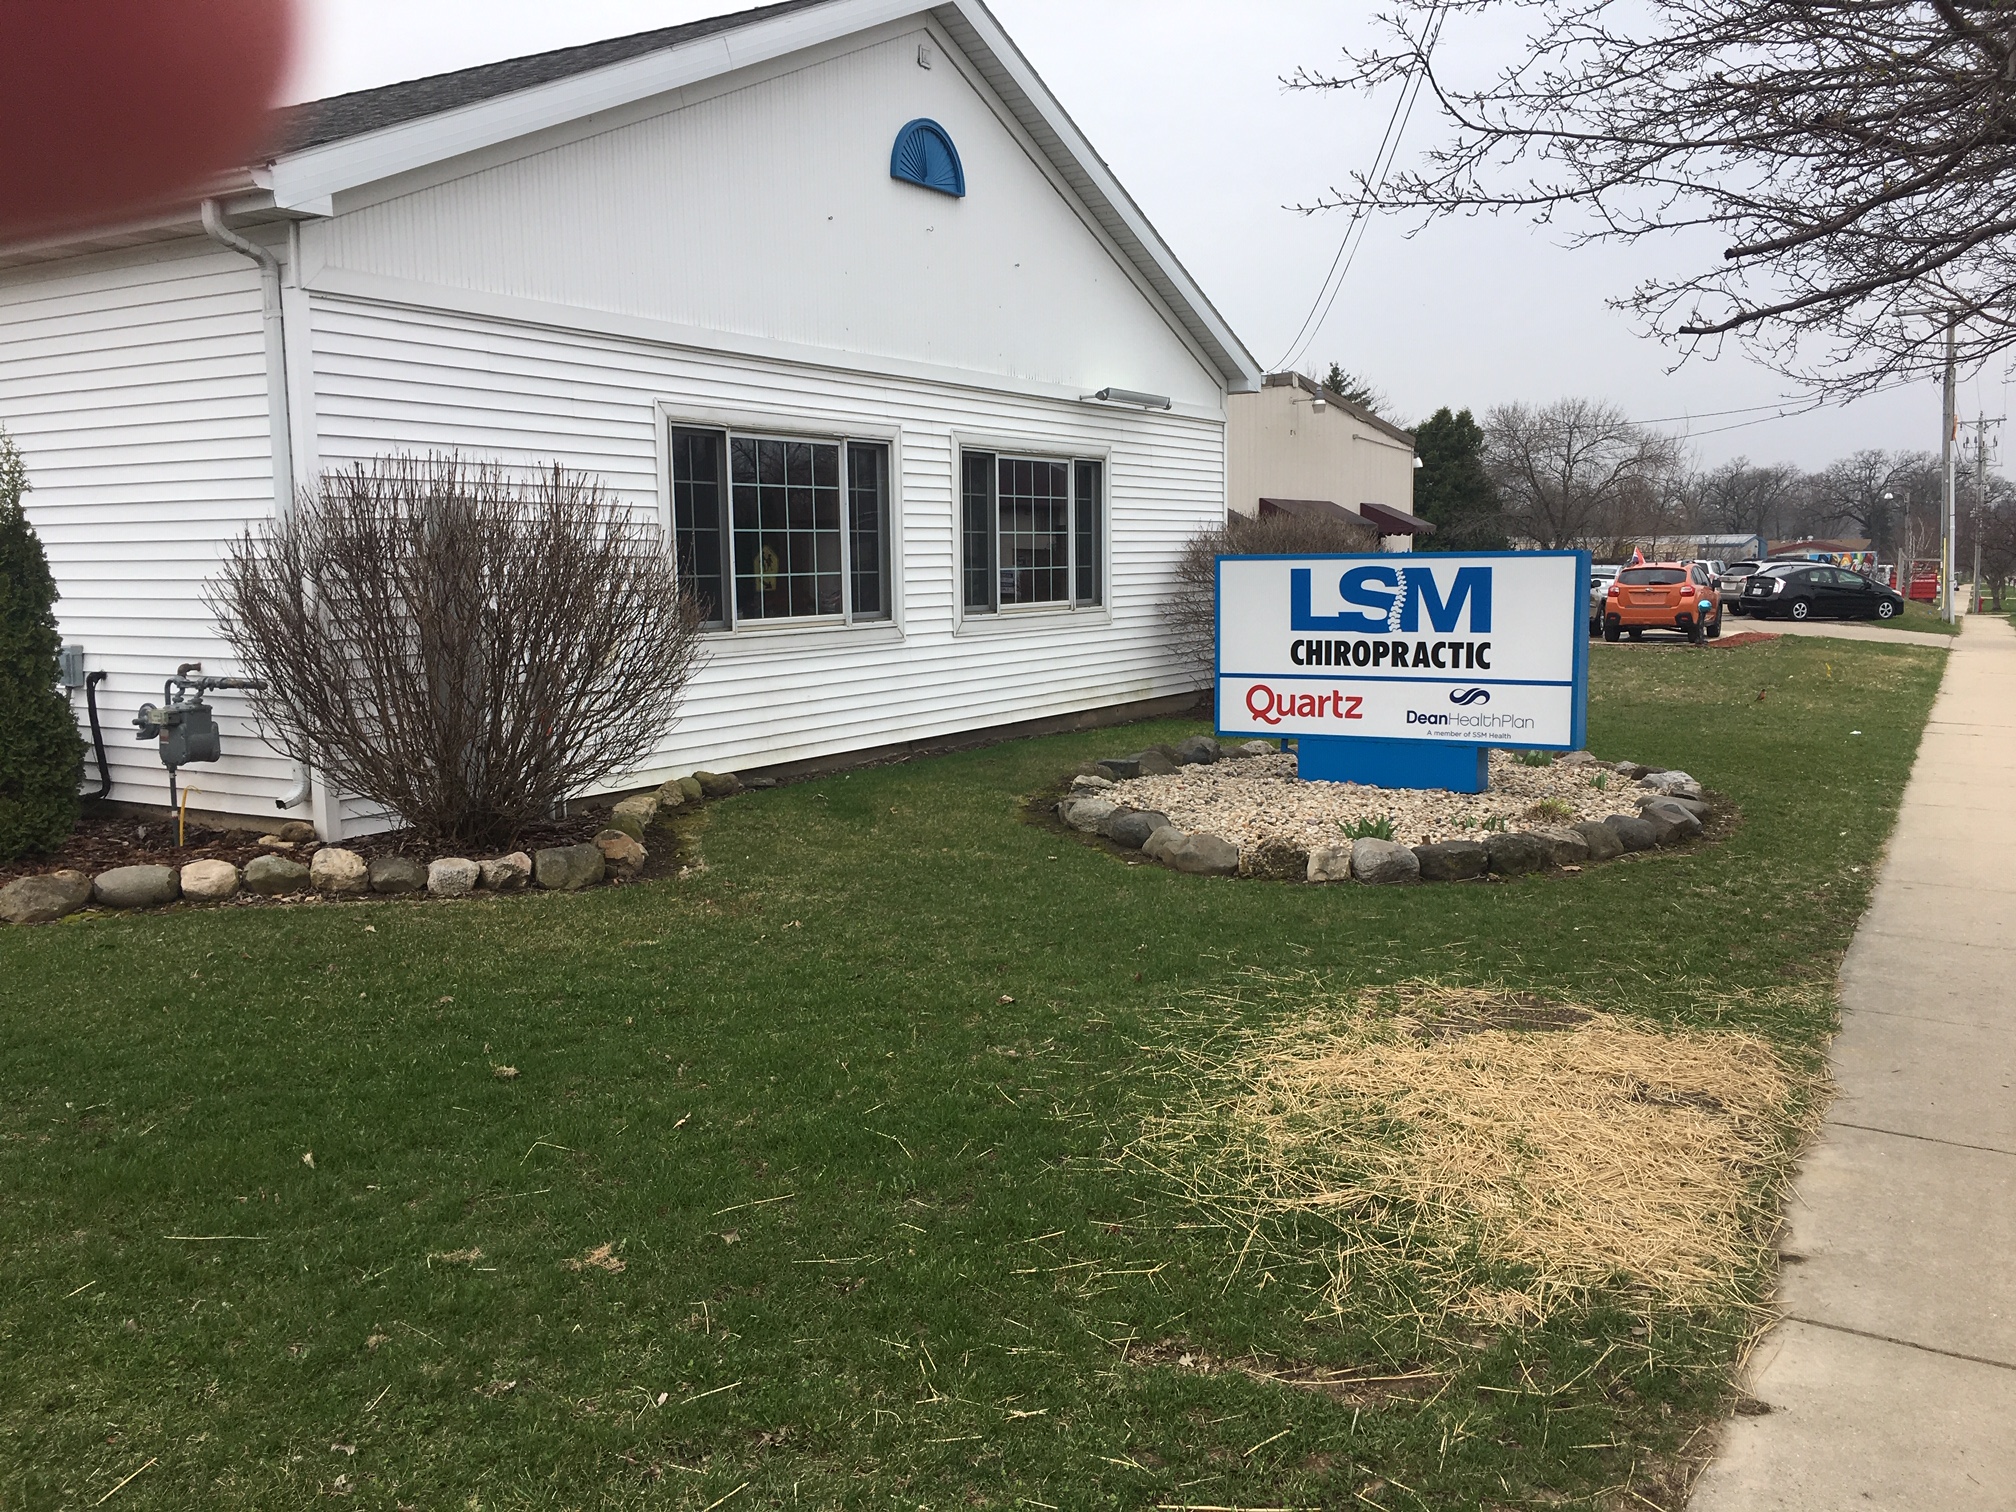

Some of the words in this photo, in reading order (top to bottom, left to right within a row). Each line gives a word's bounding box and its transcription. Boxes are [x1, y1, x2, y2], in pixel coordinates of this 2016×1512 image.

[1290, 566, 1492, 633] LSM
[1290, 640, 1491, 669] CHIROPRACTIC
[1246, 684, 1363, 725] Quartz
[1433, 730, 1461, 738] member
[1463, 730, 1471, 738] of
[1472, 731, 1488, 739] SSM
